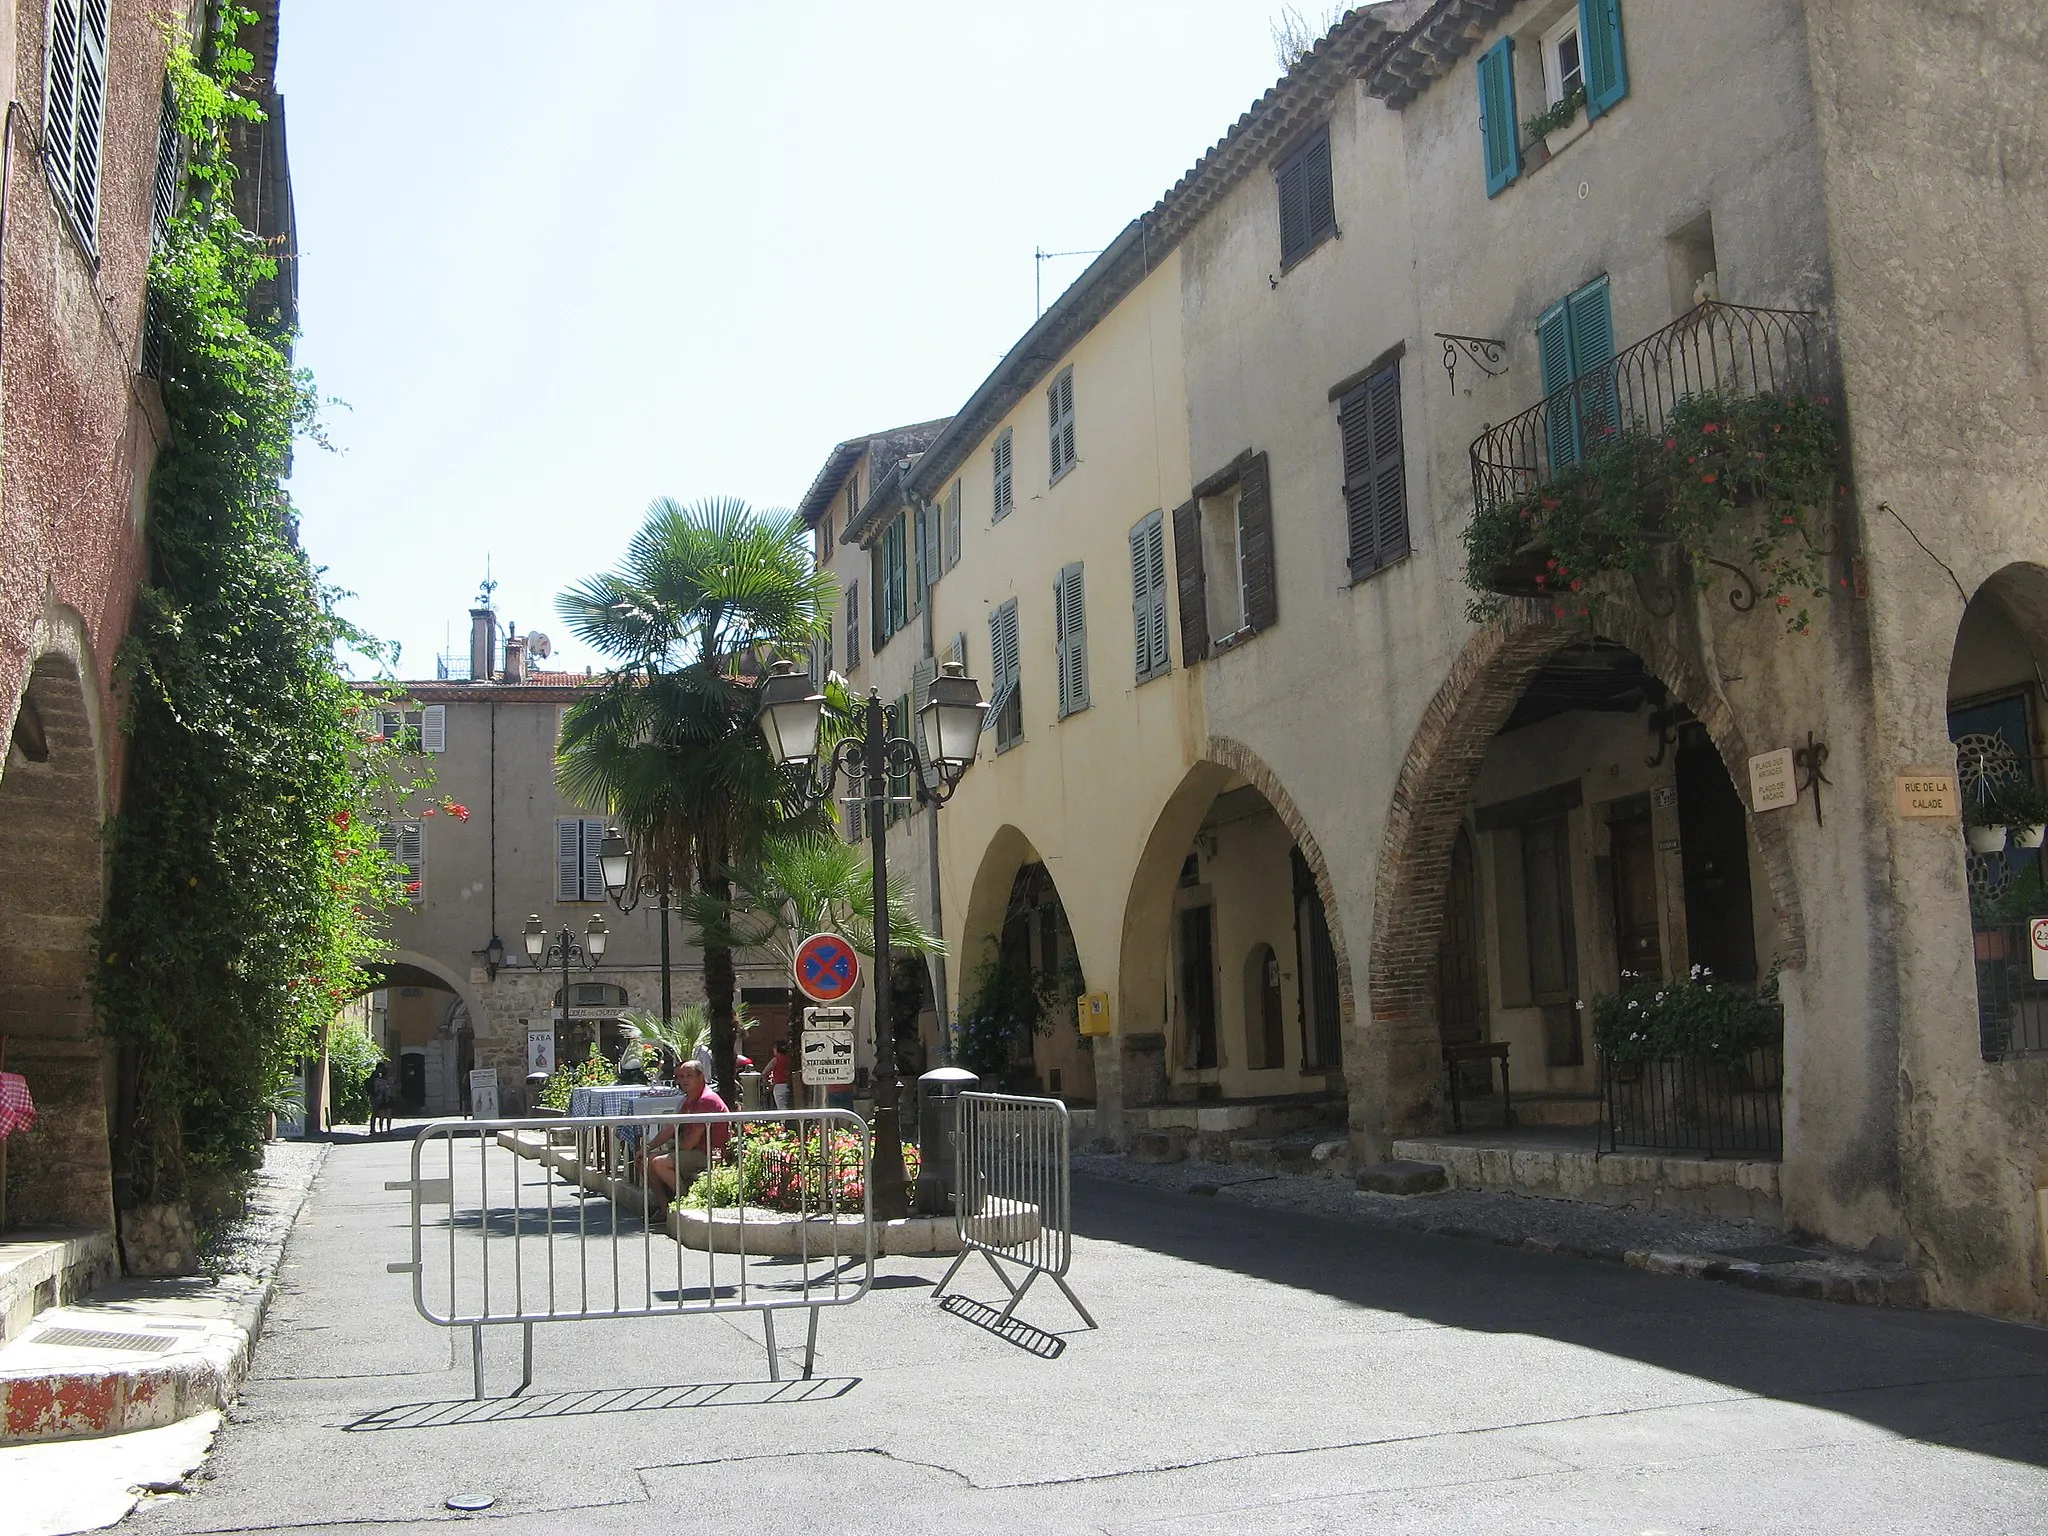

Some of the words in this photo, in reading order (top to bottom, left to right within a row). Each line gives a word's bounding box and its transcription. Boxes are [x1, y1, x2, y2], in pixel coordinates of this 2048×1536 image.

[1756, 760, 1771, 770] PLACE
[1772, 758, 1784, 767] DES
[1758, 767, 1782, 777] ARCADES
[1904, 783, 1921, 792] RUE
[1923, 783, 1934, 791] DE
[1936, 783, 1948, 791] LA
[1912, 799, 1943, 808] CALADE
[806, 1058, 851, 1066] STATIONNEMENT
